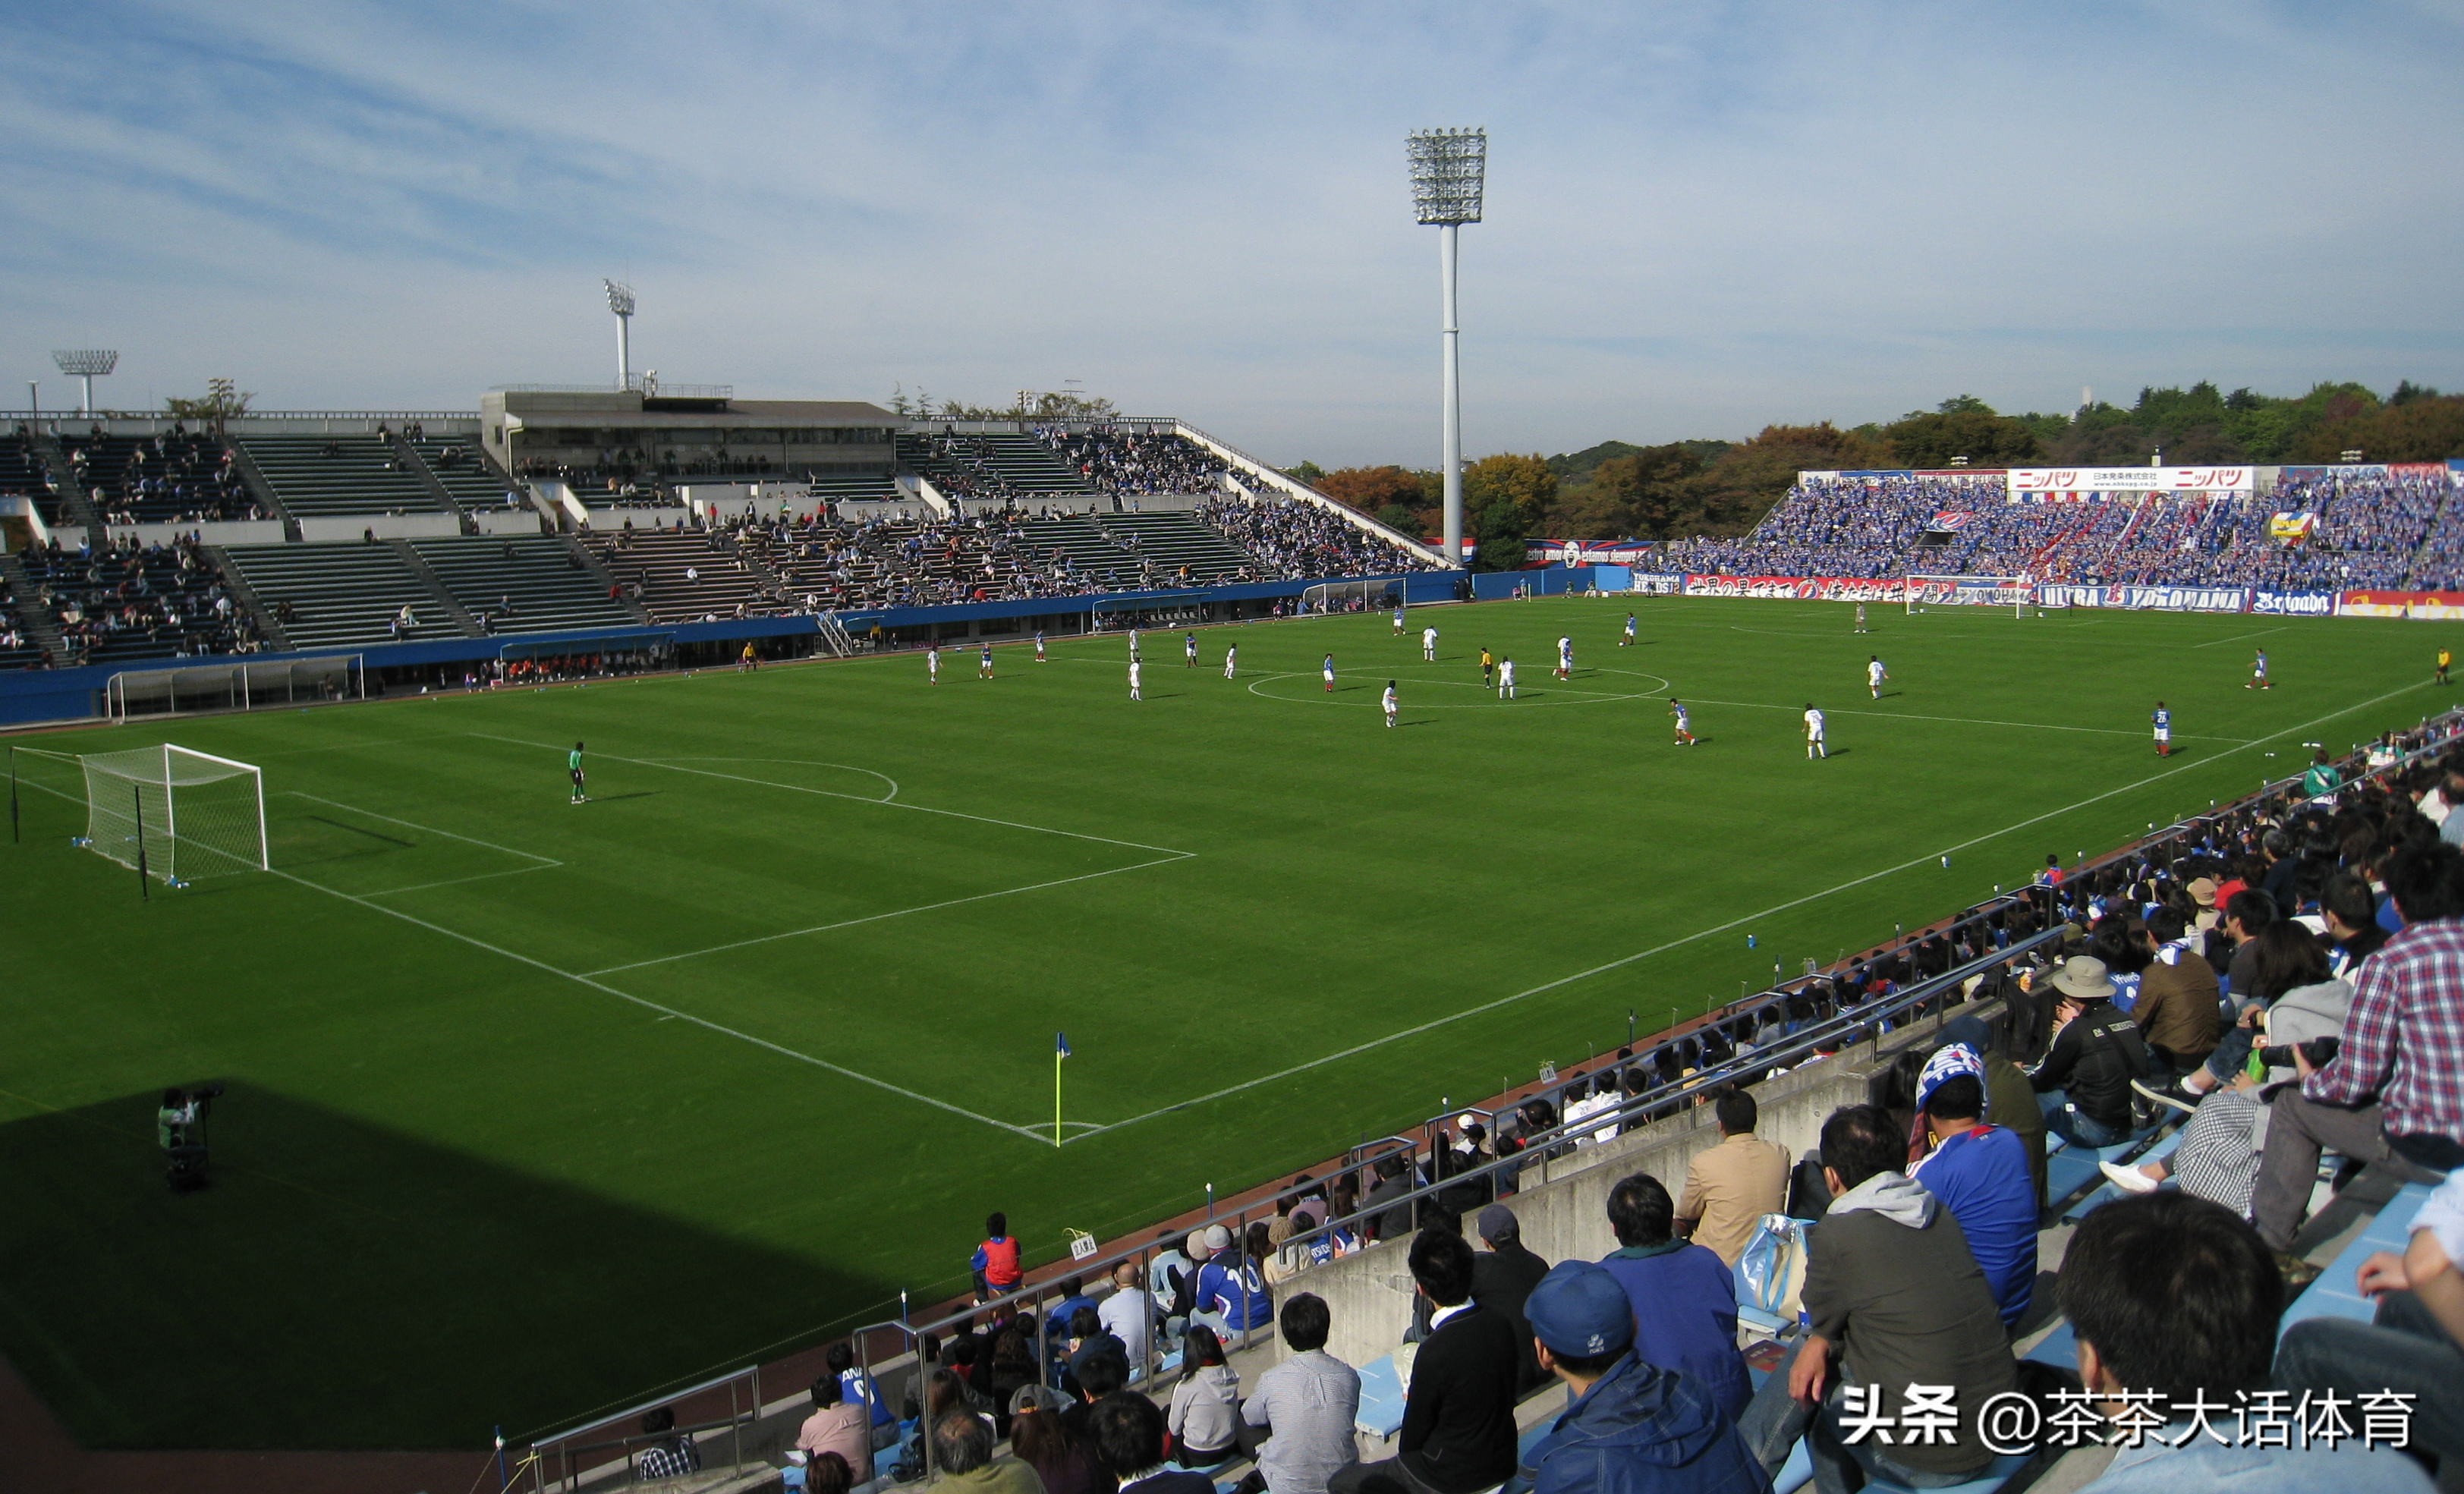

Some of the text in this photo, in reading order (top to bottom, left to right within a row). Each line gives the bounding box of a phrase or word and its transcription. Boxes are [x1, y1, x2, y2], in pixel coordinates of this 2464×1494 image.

[2016, 471, 2078, 488] ニッパツ
[2175, 470, 2243, 487] ニッパツ
[1581, 549, 1609, 562] estamos
[1610, 549, 1636, 563] siempre
[1632, 572, 1680, 582] YOKOHAMA
[1689, 577, 1792, 599] 世界の果てまで
[2044, 587, 2098, 607] ULTRA
[1226, 1263, 1261, 1294] 10
